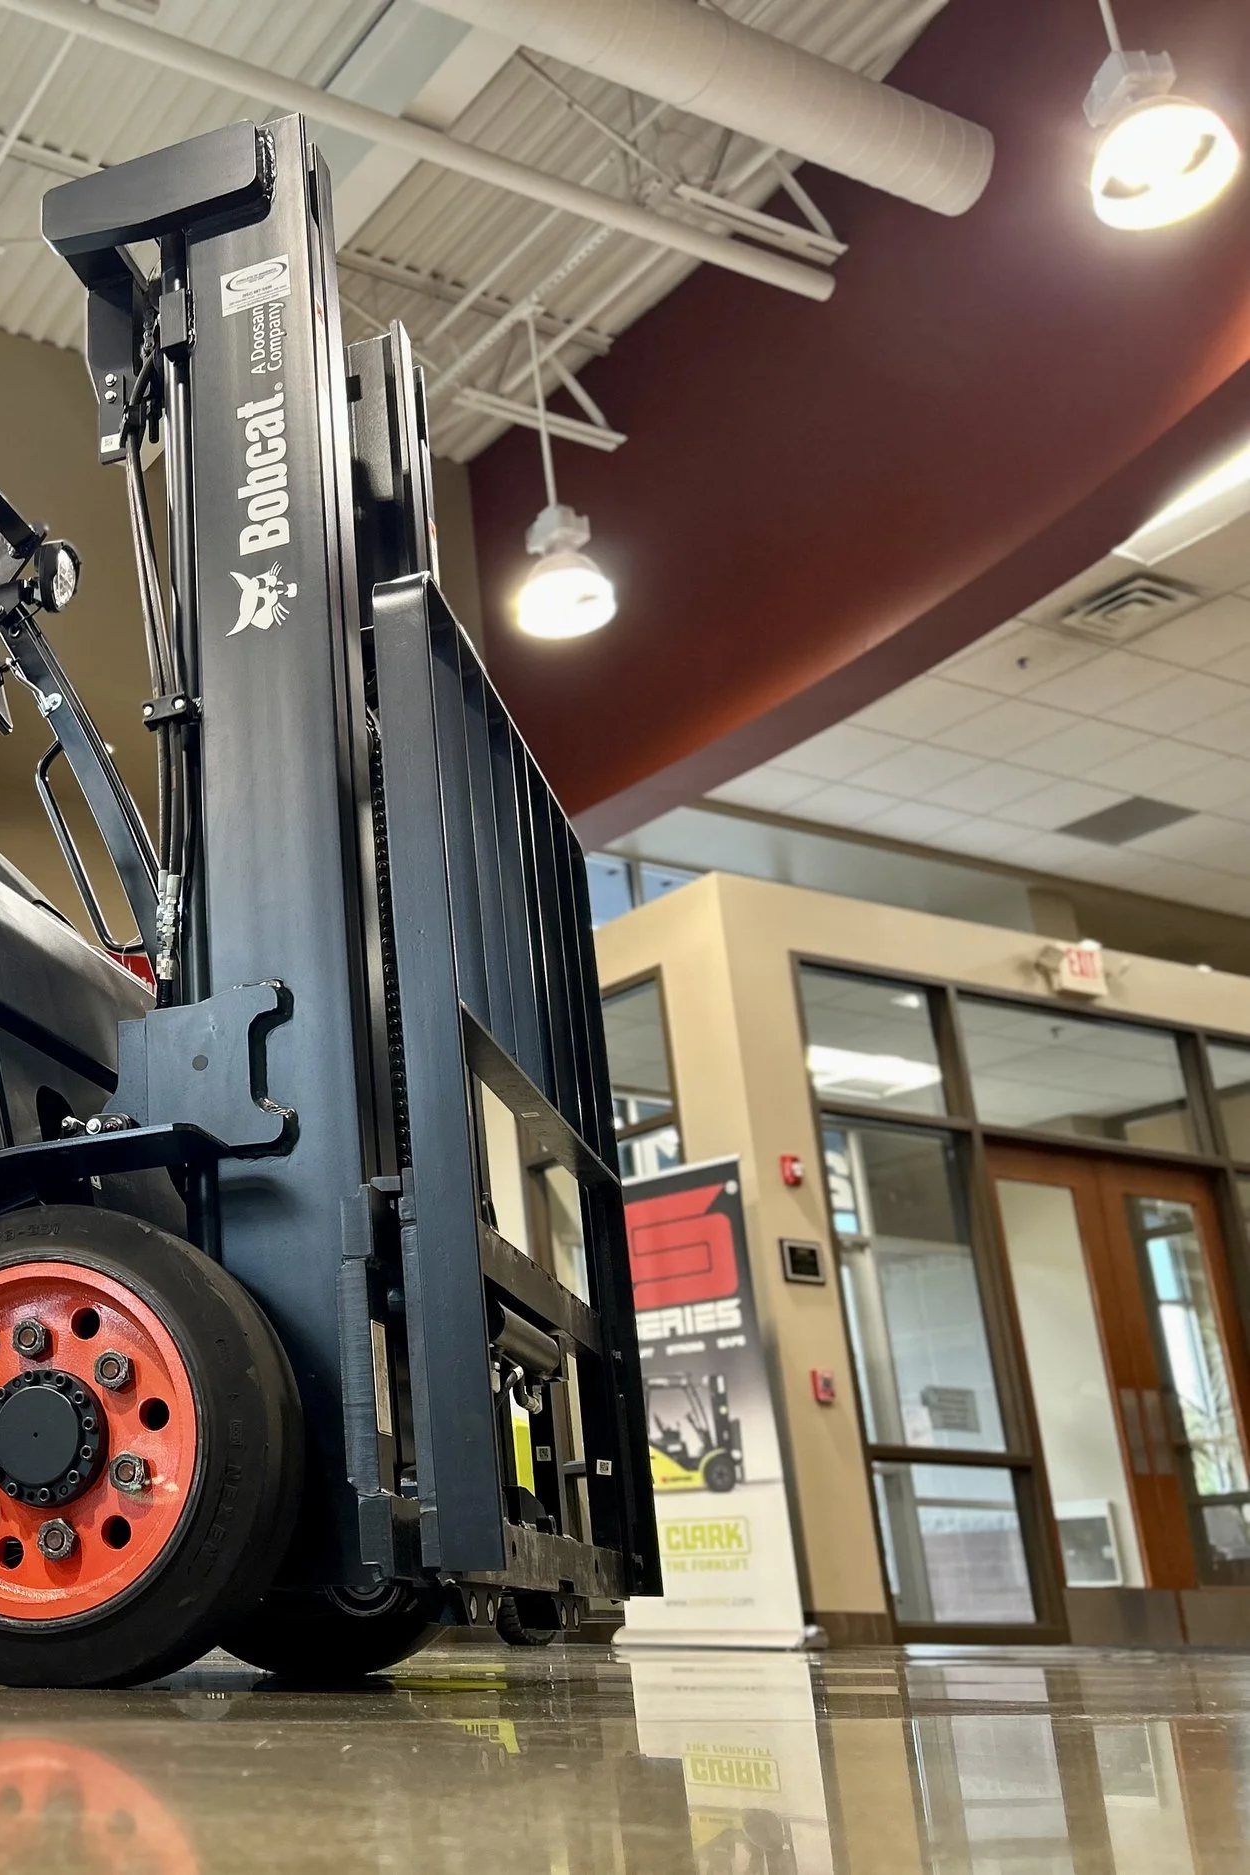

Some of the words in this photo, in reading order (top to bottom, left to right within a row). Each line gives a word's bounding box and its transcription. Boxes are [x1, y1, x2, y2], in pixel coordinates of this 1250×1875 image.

[250, 304, 265, 362] Doosan
[267, 302, 286, 372] Company
[250, 362, 266, 374] A
[635, 1298, 742, 1341] ERIES
[665, 1523, 743, 1551] CLARK
[667, 1560, 688, 1571] THE
[692, 1557, 749, 1571] FORKLIFT
